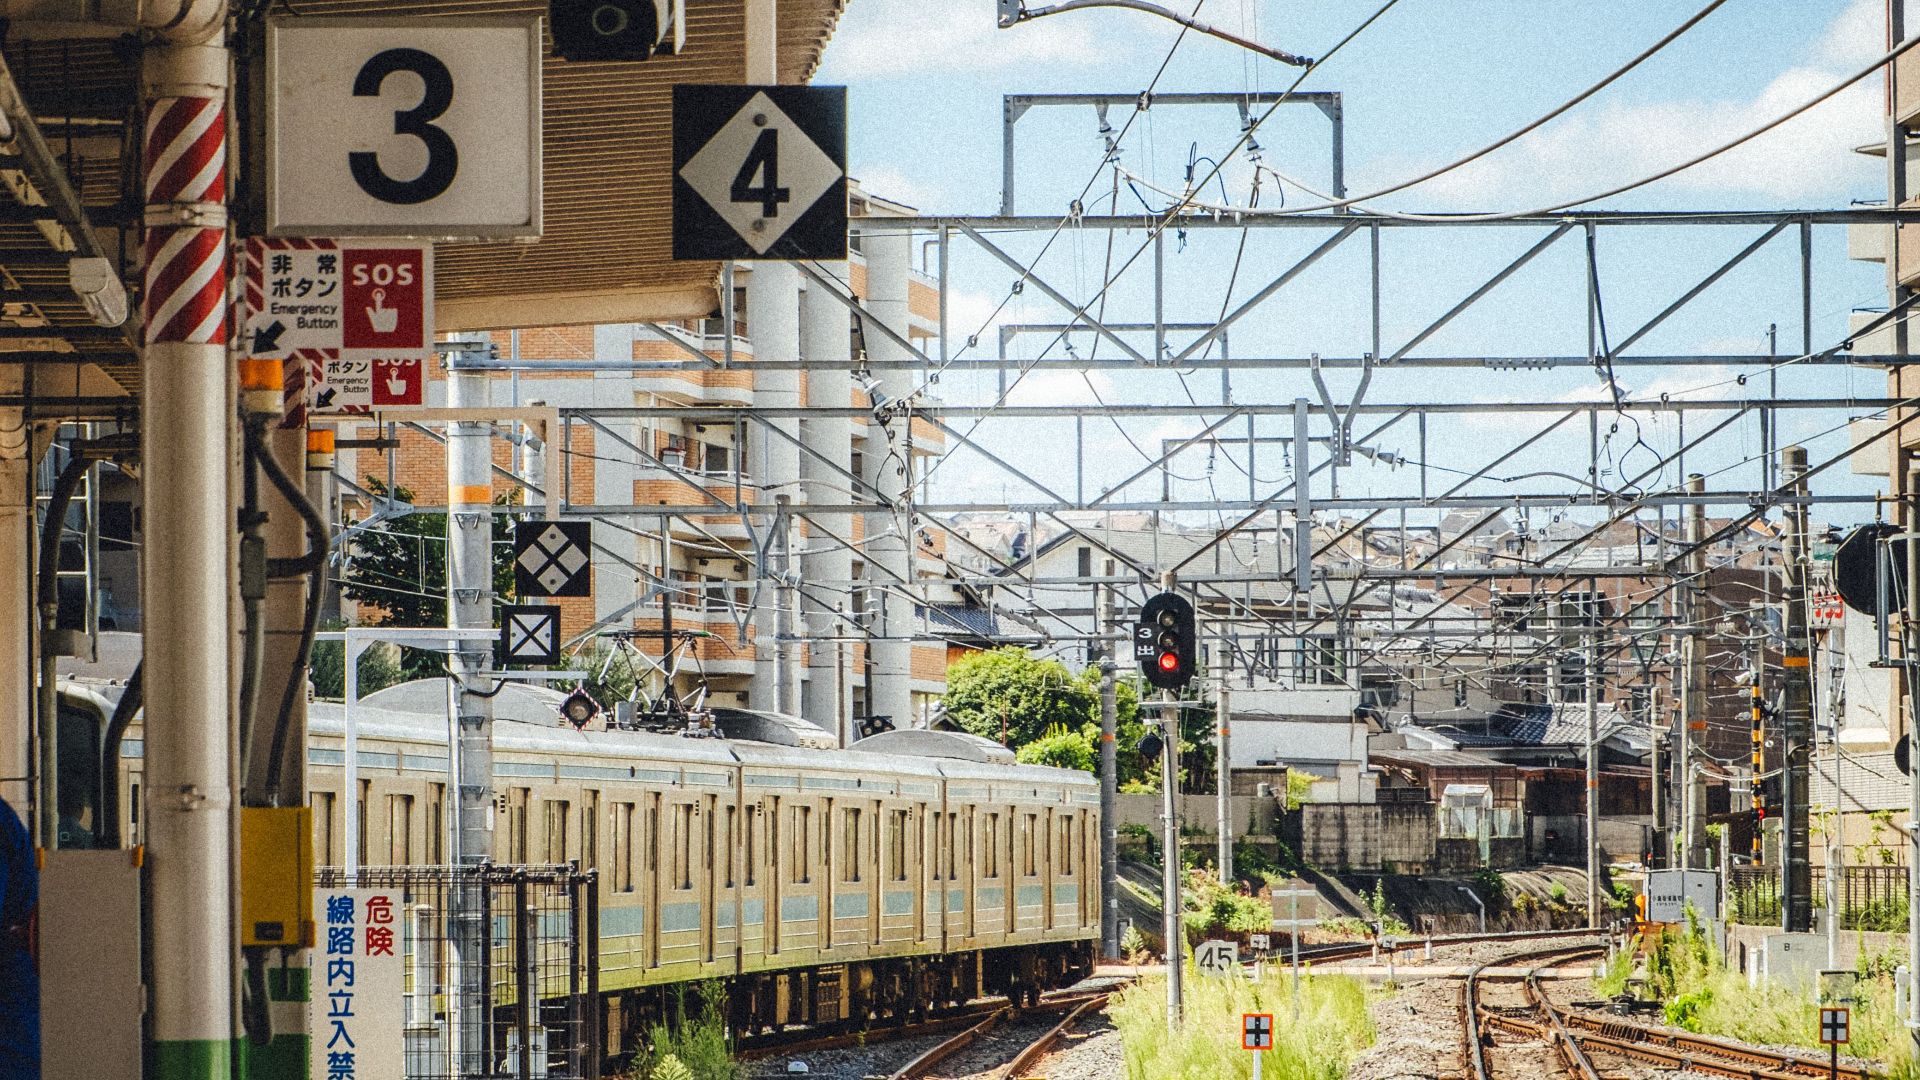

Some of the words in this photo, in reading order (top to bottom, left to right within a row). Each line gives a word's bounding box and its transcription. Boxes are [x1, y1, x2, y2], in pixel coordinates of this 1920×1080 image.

[348, 47, 459, 206] 3
[729, 128, 790, 219] 4
[271, 254, 337, 275] 非常
[352, 263, 414, 286] SOS
[271, 277, 337, 298] ボタン
[271, 302, 338, 316] Emergency
[296, 316, 338, 329] Button
[327, 361, 368, 374] ボタン
[327, 376, 369, 385] Emergency
[343, 385, 369, 393] Button
[365, 896, 394, 956] 危険
[1200, 947, 1232, 971] 45
[326, 895, 355, 1080] 線路内立入禁
